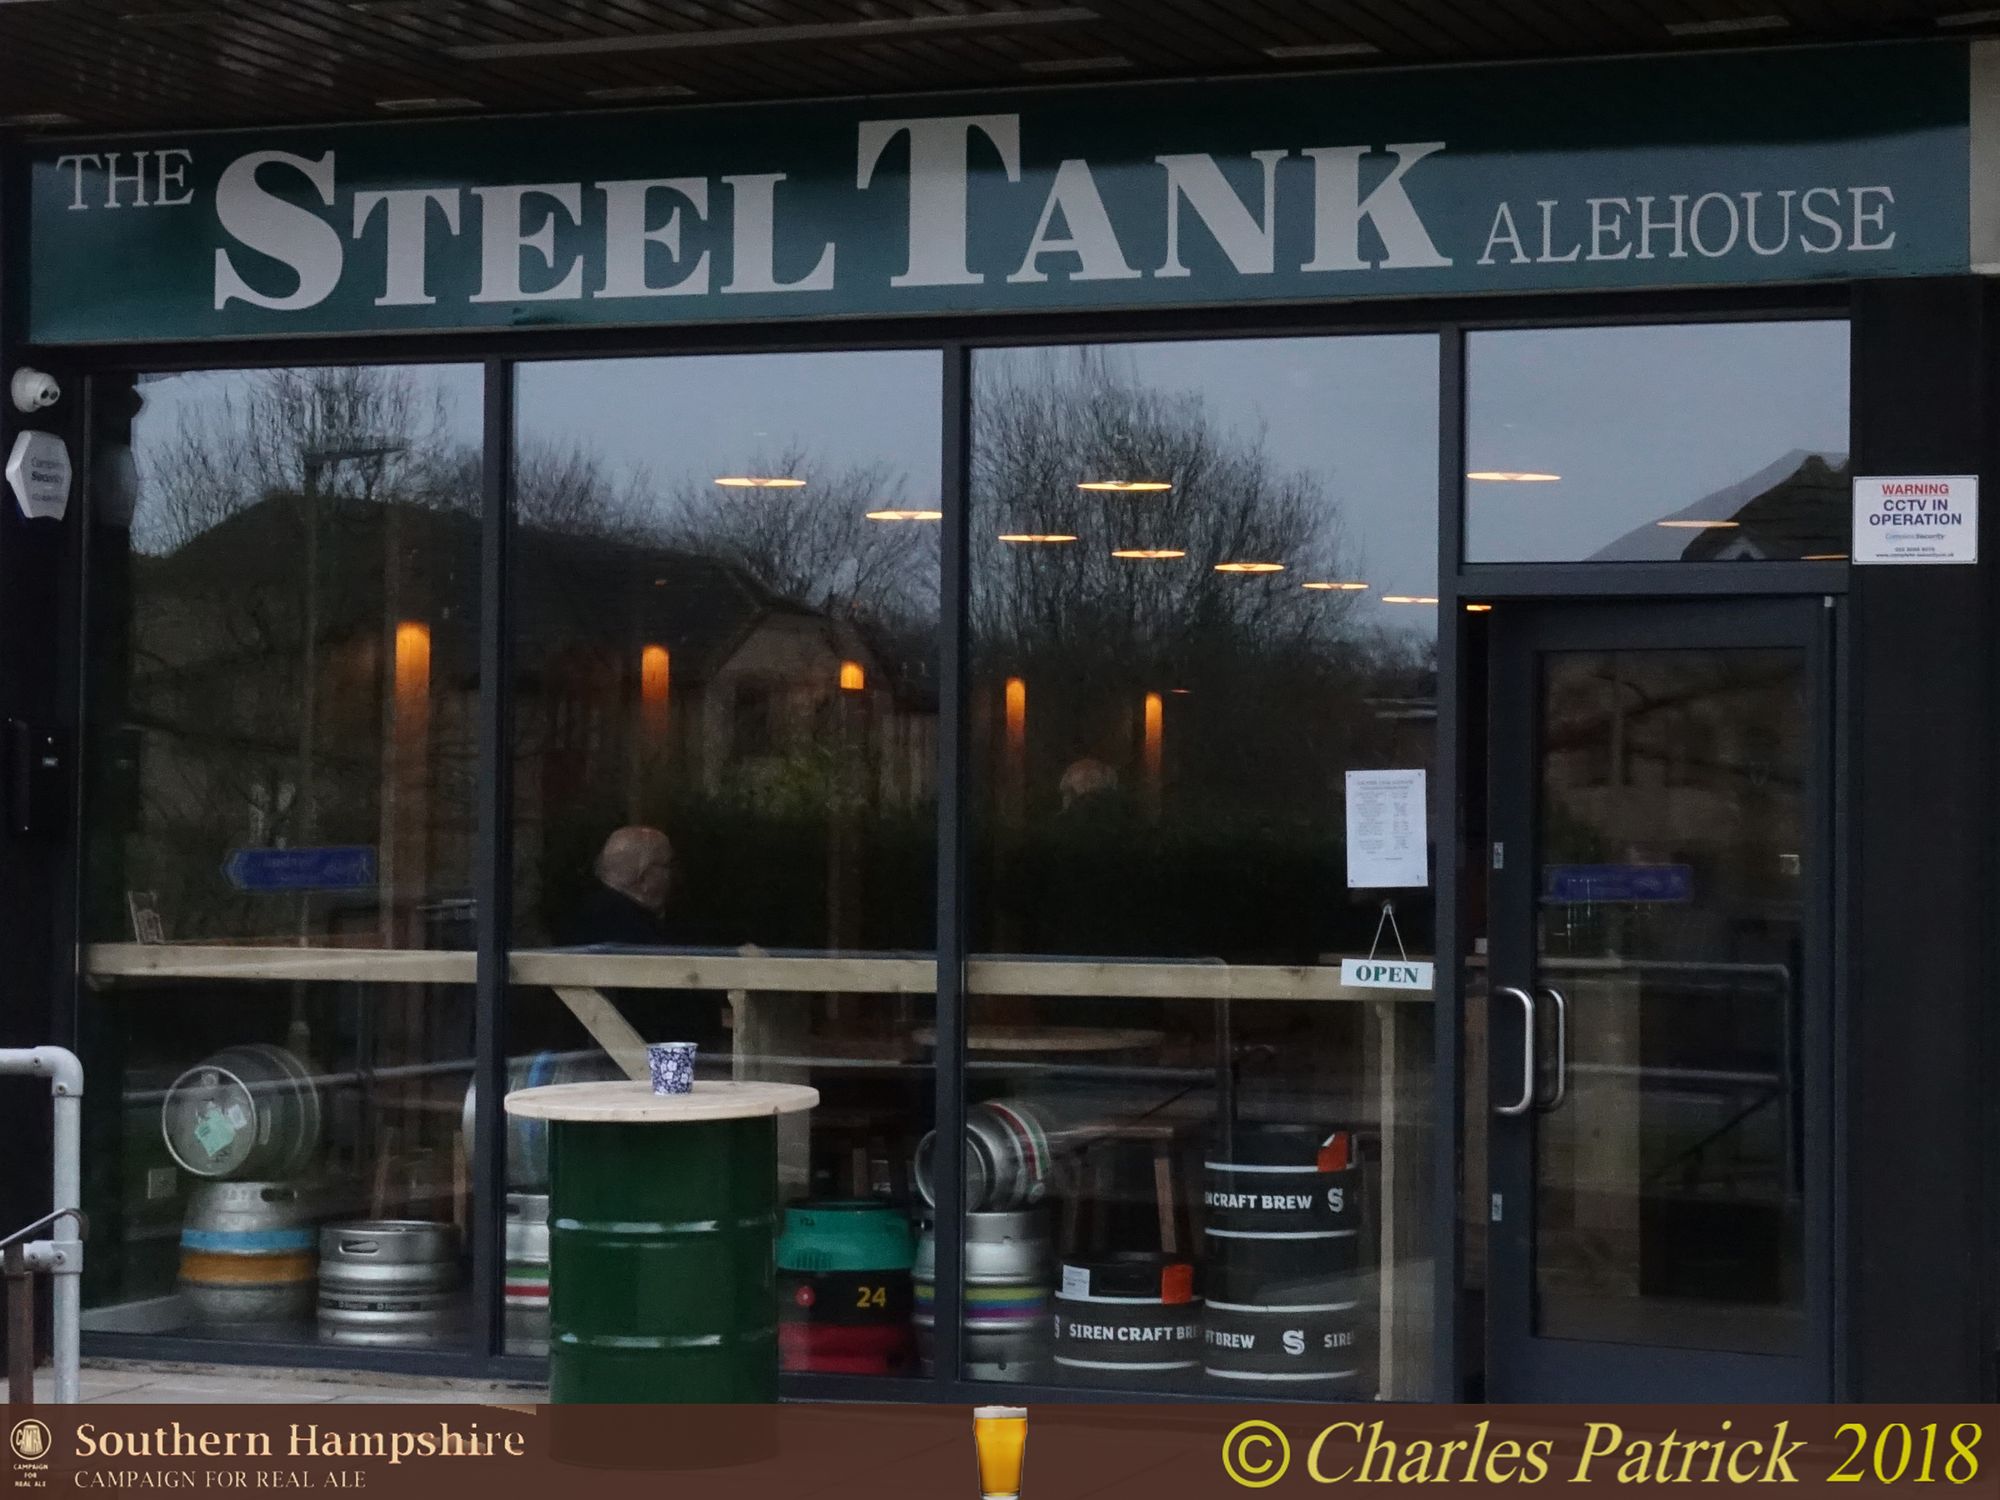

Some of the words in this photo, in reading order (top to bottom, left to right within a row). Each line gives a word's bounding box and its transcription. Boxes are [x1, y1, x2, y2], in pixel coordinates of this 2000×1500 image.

[55, 147, 195, 211] THE
[213, 149, 836, 312] STEEL
[857, 113, 1453, 289] TANK
[1477, 185, 1897, 266] ALEHOUSE
[1881, 483, 1950, 496] WARNING
[1883, 499, 1927, 512] CCTV
[1932, 498, 1948, 511] IN
[1869, 513, 1962, 526] OPERATION
[1355, 964, 1419, 984] OPEN
[1213, 1193, 1258, 1209] CRAFT
[1261, 1194, 1313, 1210] BREW
[856, 1286, 887, 1308] 24
[1069, 1322, 1114, 1341] SIREN
[1117, 1325, 1173, 1342] CRAFT
[1216, 1332, 1256, 1349] BREW
[1324, 1331, 1353, 1348] SIRE
